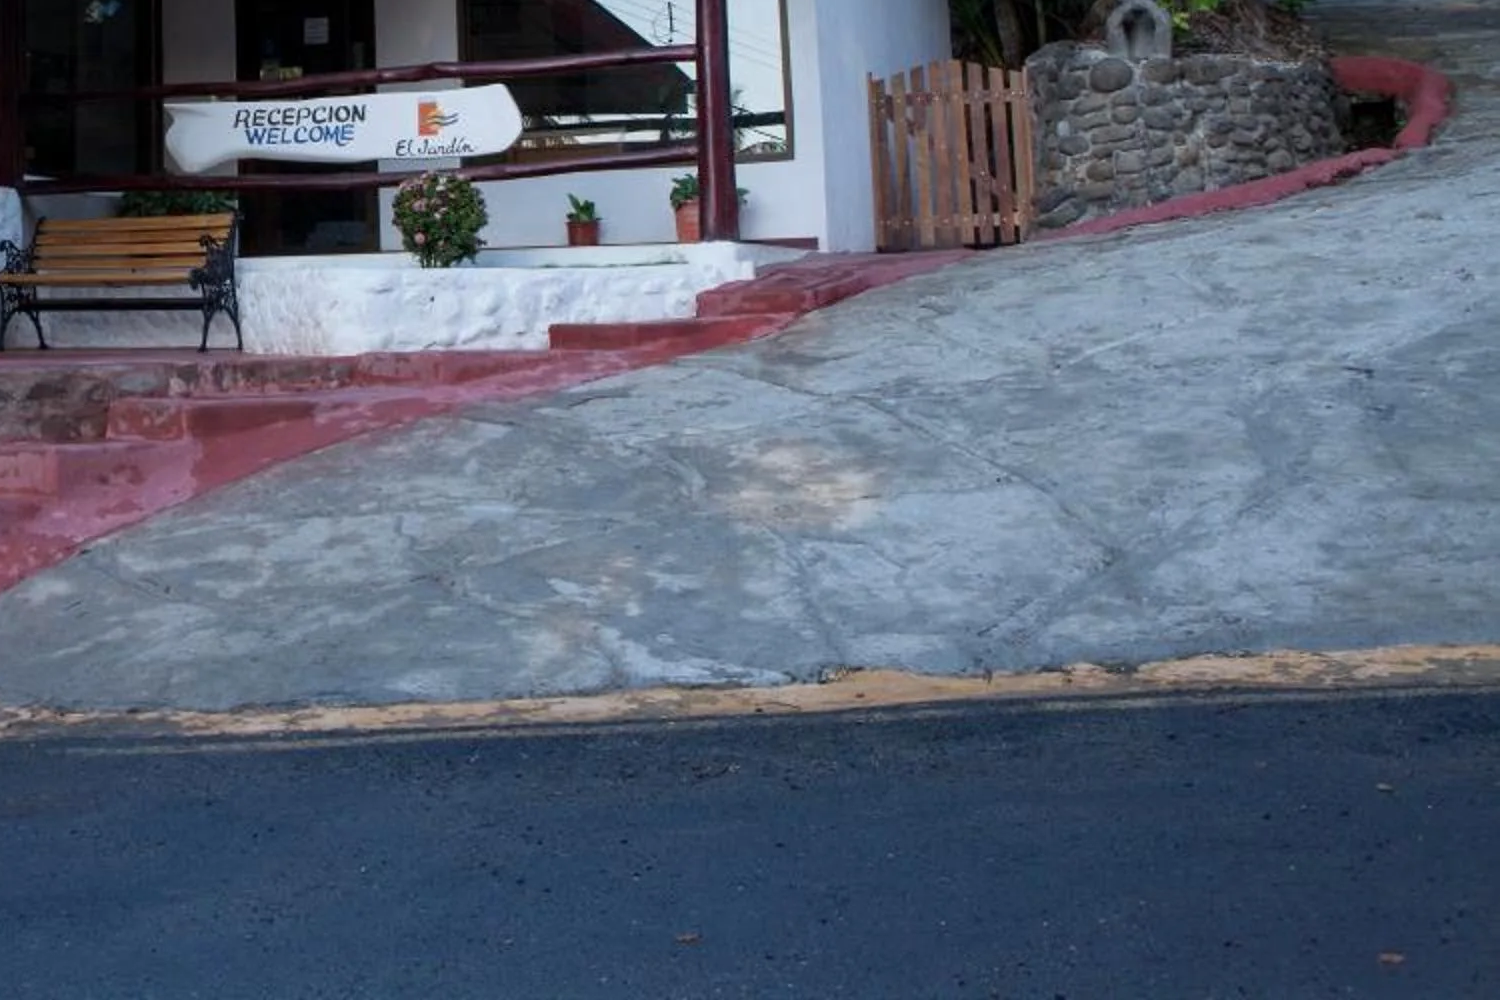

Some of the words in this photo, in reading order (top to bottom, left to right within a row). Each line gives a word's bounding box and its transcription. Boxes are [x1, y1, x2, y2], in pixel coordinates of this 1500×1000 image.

[233, 104, 367, 129] RECEPCION
[244, 124, 357, 146] WELCOME
[395, 140, 414, 156] El
